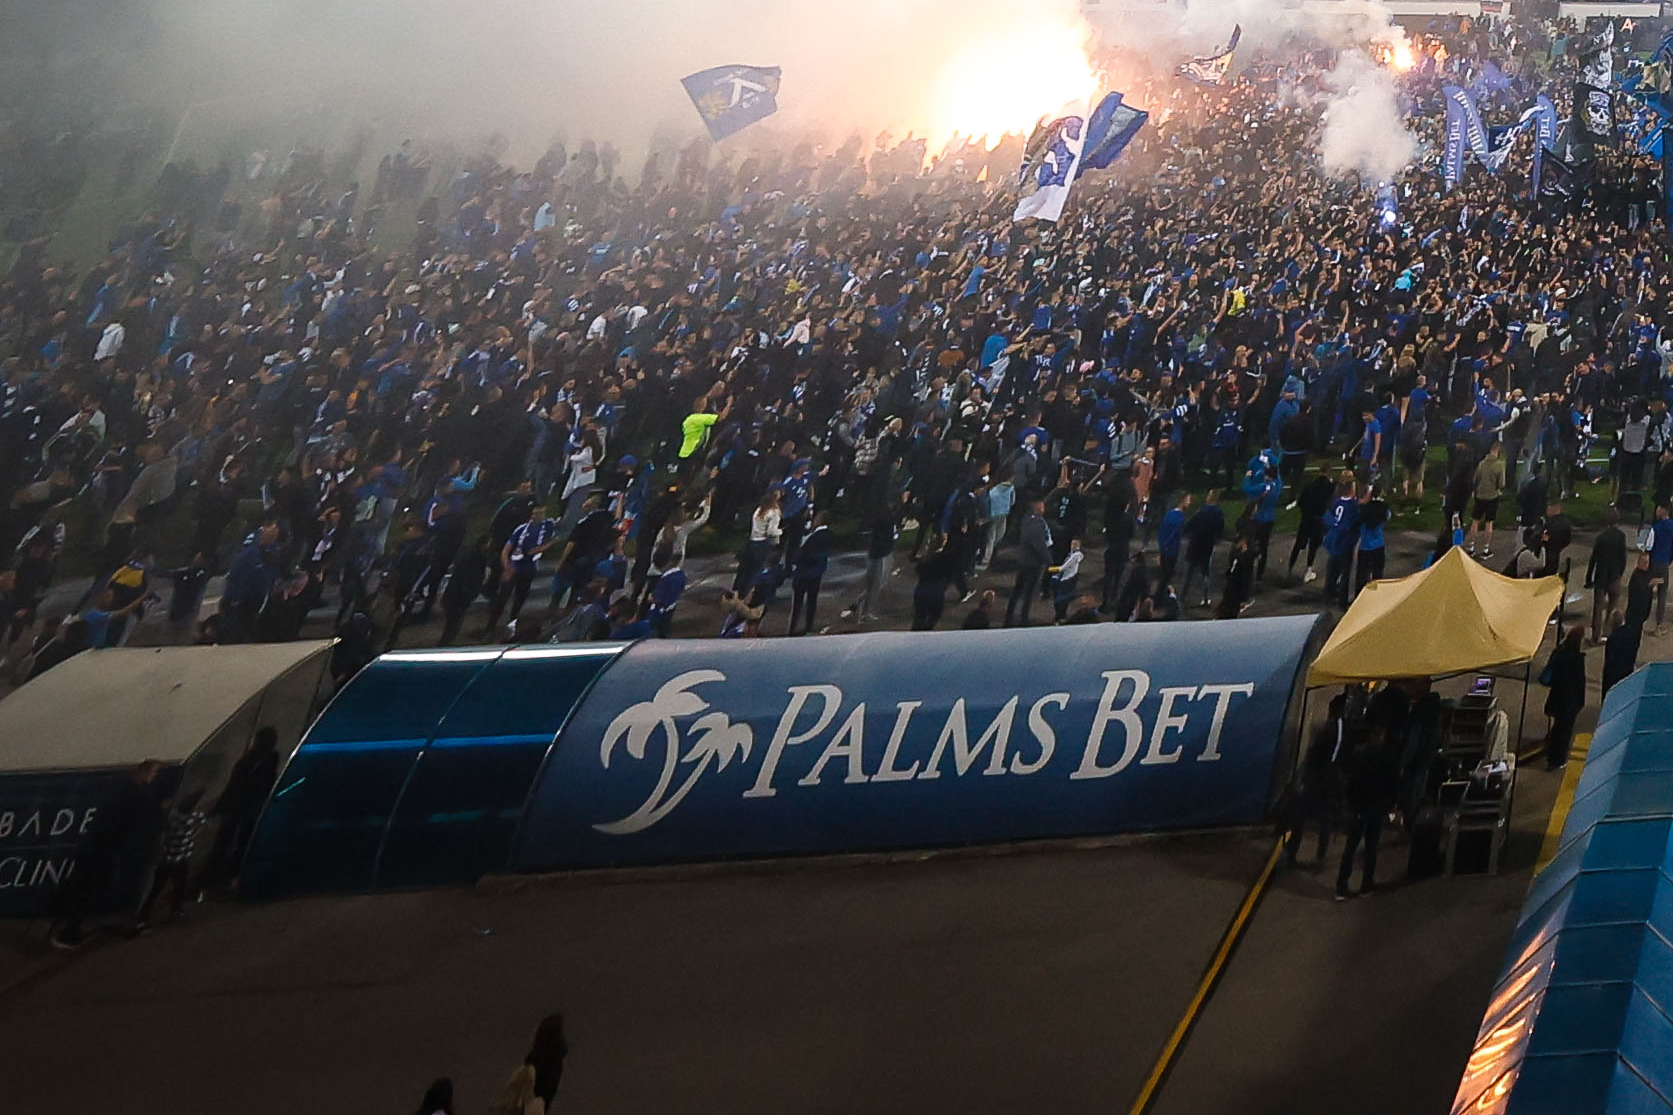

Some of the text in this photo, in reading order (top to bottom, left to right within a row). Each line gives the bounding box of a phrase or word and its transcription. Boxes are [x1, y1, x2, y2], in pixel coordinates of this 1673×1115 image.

[743, 668, 1255, 798] PALMS BET
[0, 806, 97, 838] BADE
[0, 855, 76, 890] CLINI
